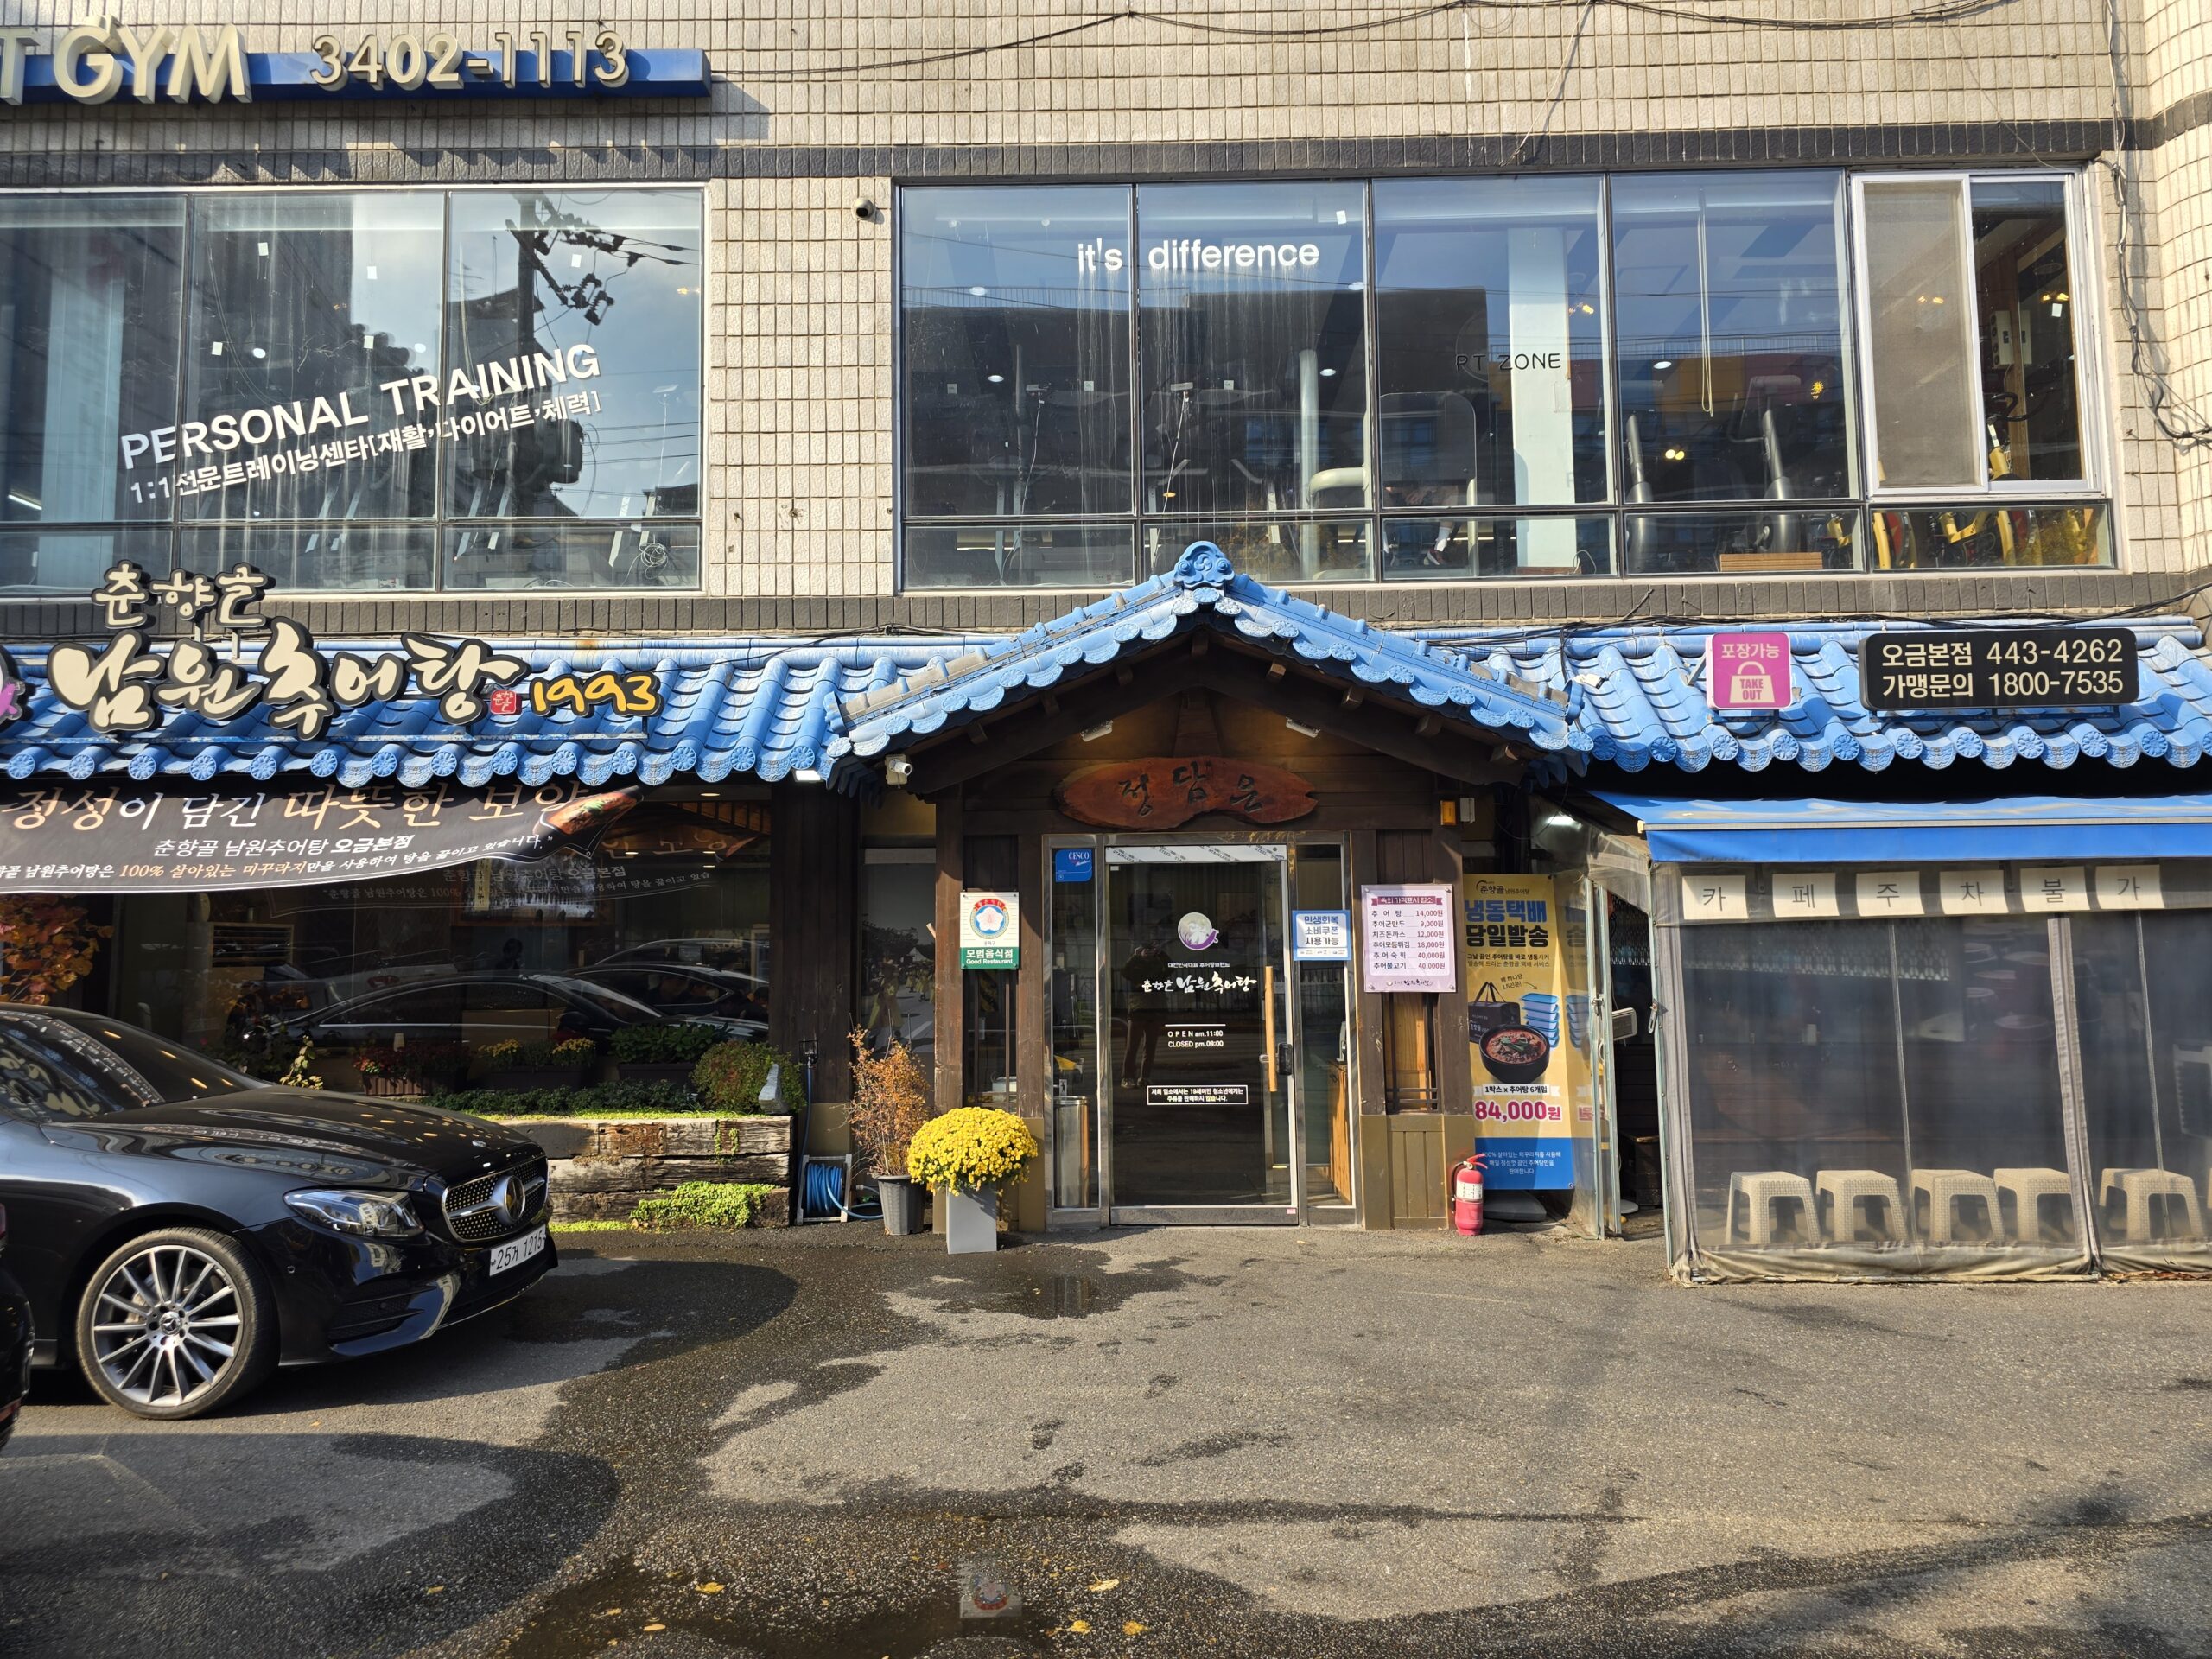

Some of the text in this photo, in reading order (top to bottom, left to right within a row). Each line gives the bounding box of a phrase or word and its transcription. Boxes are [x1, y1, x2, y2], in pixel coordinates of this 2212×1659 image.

[54, 21, 251, 105] GYM
[310, 30, 630, 91] 3402-1113
[1077, 238, 1320, 272] it's difference
[1456, 353, 1561, 372] PT ZONE
[121, 344, 601, 469] PERSONAL TRAINING
[94, 561, 270, 628] 춘향골
[1721, 642, 1780, 659] 포장가능
[1881, 639, 2124, 668] 오금본점 443-4262
[50, 620, 524, 736] 남원추어탕
[1739, 678, 1764, 690] TAKE
[1882, 670, 2124, 699] 가맹문의 1800-7535
[533, 674, 656, 712] 1993
[1742, 690, 1763, 701] OUT
[2, 787, 164, 830] 정성이
[182, 792, 265, 830] 담긴
[284, 781, 454, 831] 따뜻한
[154, 834, 416, 857] 춘향골 남원추어탕 오금본점
[26, 865, 115, 879] 남원추어탕은
[119, 865, 164, 878] 100%
[169, 864, 238, 878] 살아있는
[242, 861, 335, 876] 미꾸라지만을
[339, 855, 398, 870] 사용하여
[404, 851, 432, 863] 탕을
[435, 846, 479, 861] 끓이고
[1480, 886, 1503, 894] 춘향골
[1702, 877, 2141, 912] 카 페 주 차 불 가
[1305, 915, 1338, 925] 민생회복
[1465, 899, 1548, 923] 냉동택배
[1305, 926, 1339, 935] 소비쿠폰
[1305, 937, 1339, 945] 사용가능
[1466, 925, 1549, 947] 당일발송
[966, 949, 1014, 959] 모범음식점
[1485, 1085, 1503, 1094] 1박스
[1509, 1085, 1529, 1094] 추어탕
[1529, 1085, 1548, 1094] 6개입
[1474, 1100, 1561, 1122] 84,000원
[524, 1230, 543, 1258] 1215
